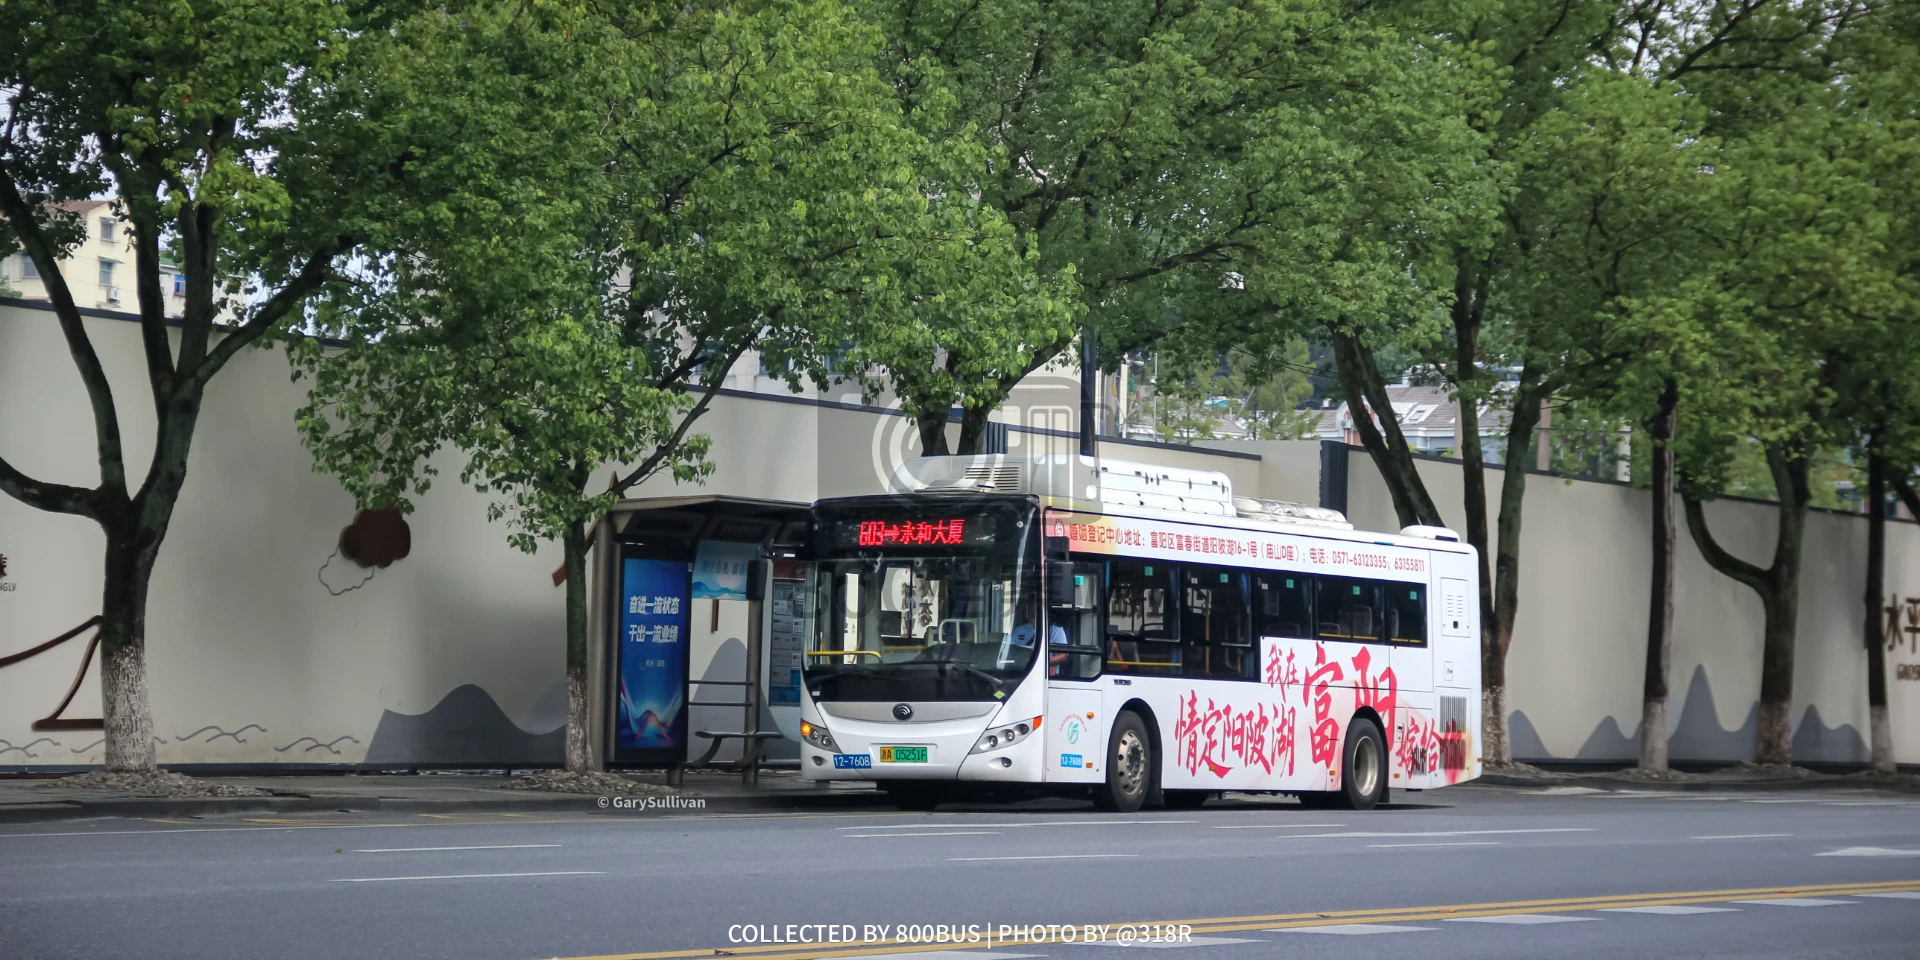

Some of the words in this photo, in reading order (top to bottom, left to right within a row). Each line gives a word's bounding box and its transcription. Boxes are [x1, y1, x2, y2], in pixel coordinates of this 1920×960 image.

[899, 519, 965, 545] 永和大厦
[629, 595, 680, 615] 奋进一流状态
[628, 624, 679, 643] 干出一流业绩
[1175, 689, 1297, 779] 情定阳陂湖
[833, 755, 871, 768] 12-7608
[1061, 755, 1082, 766] 12-7608
